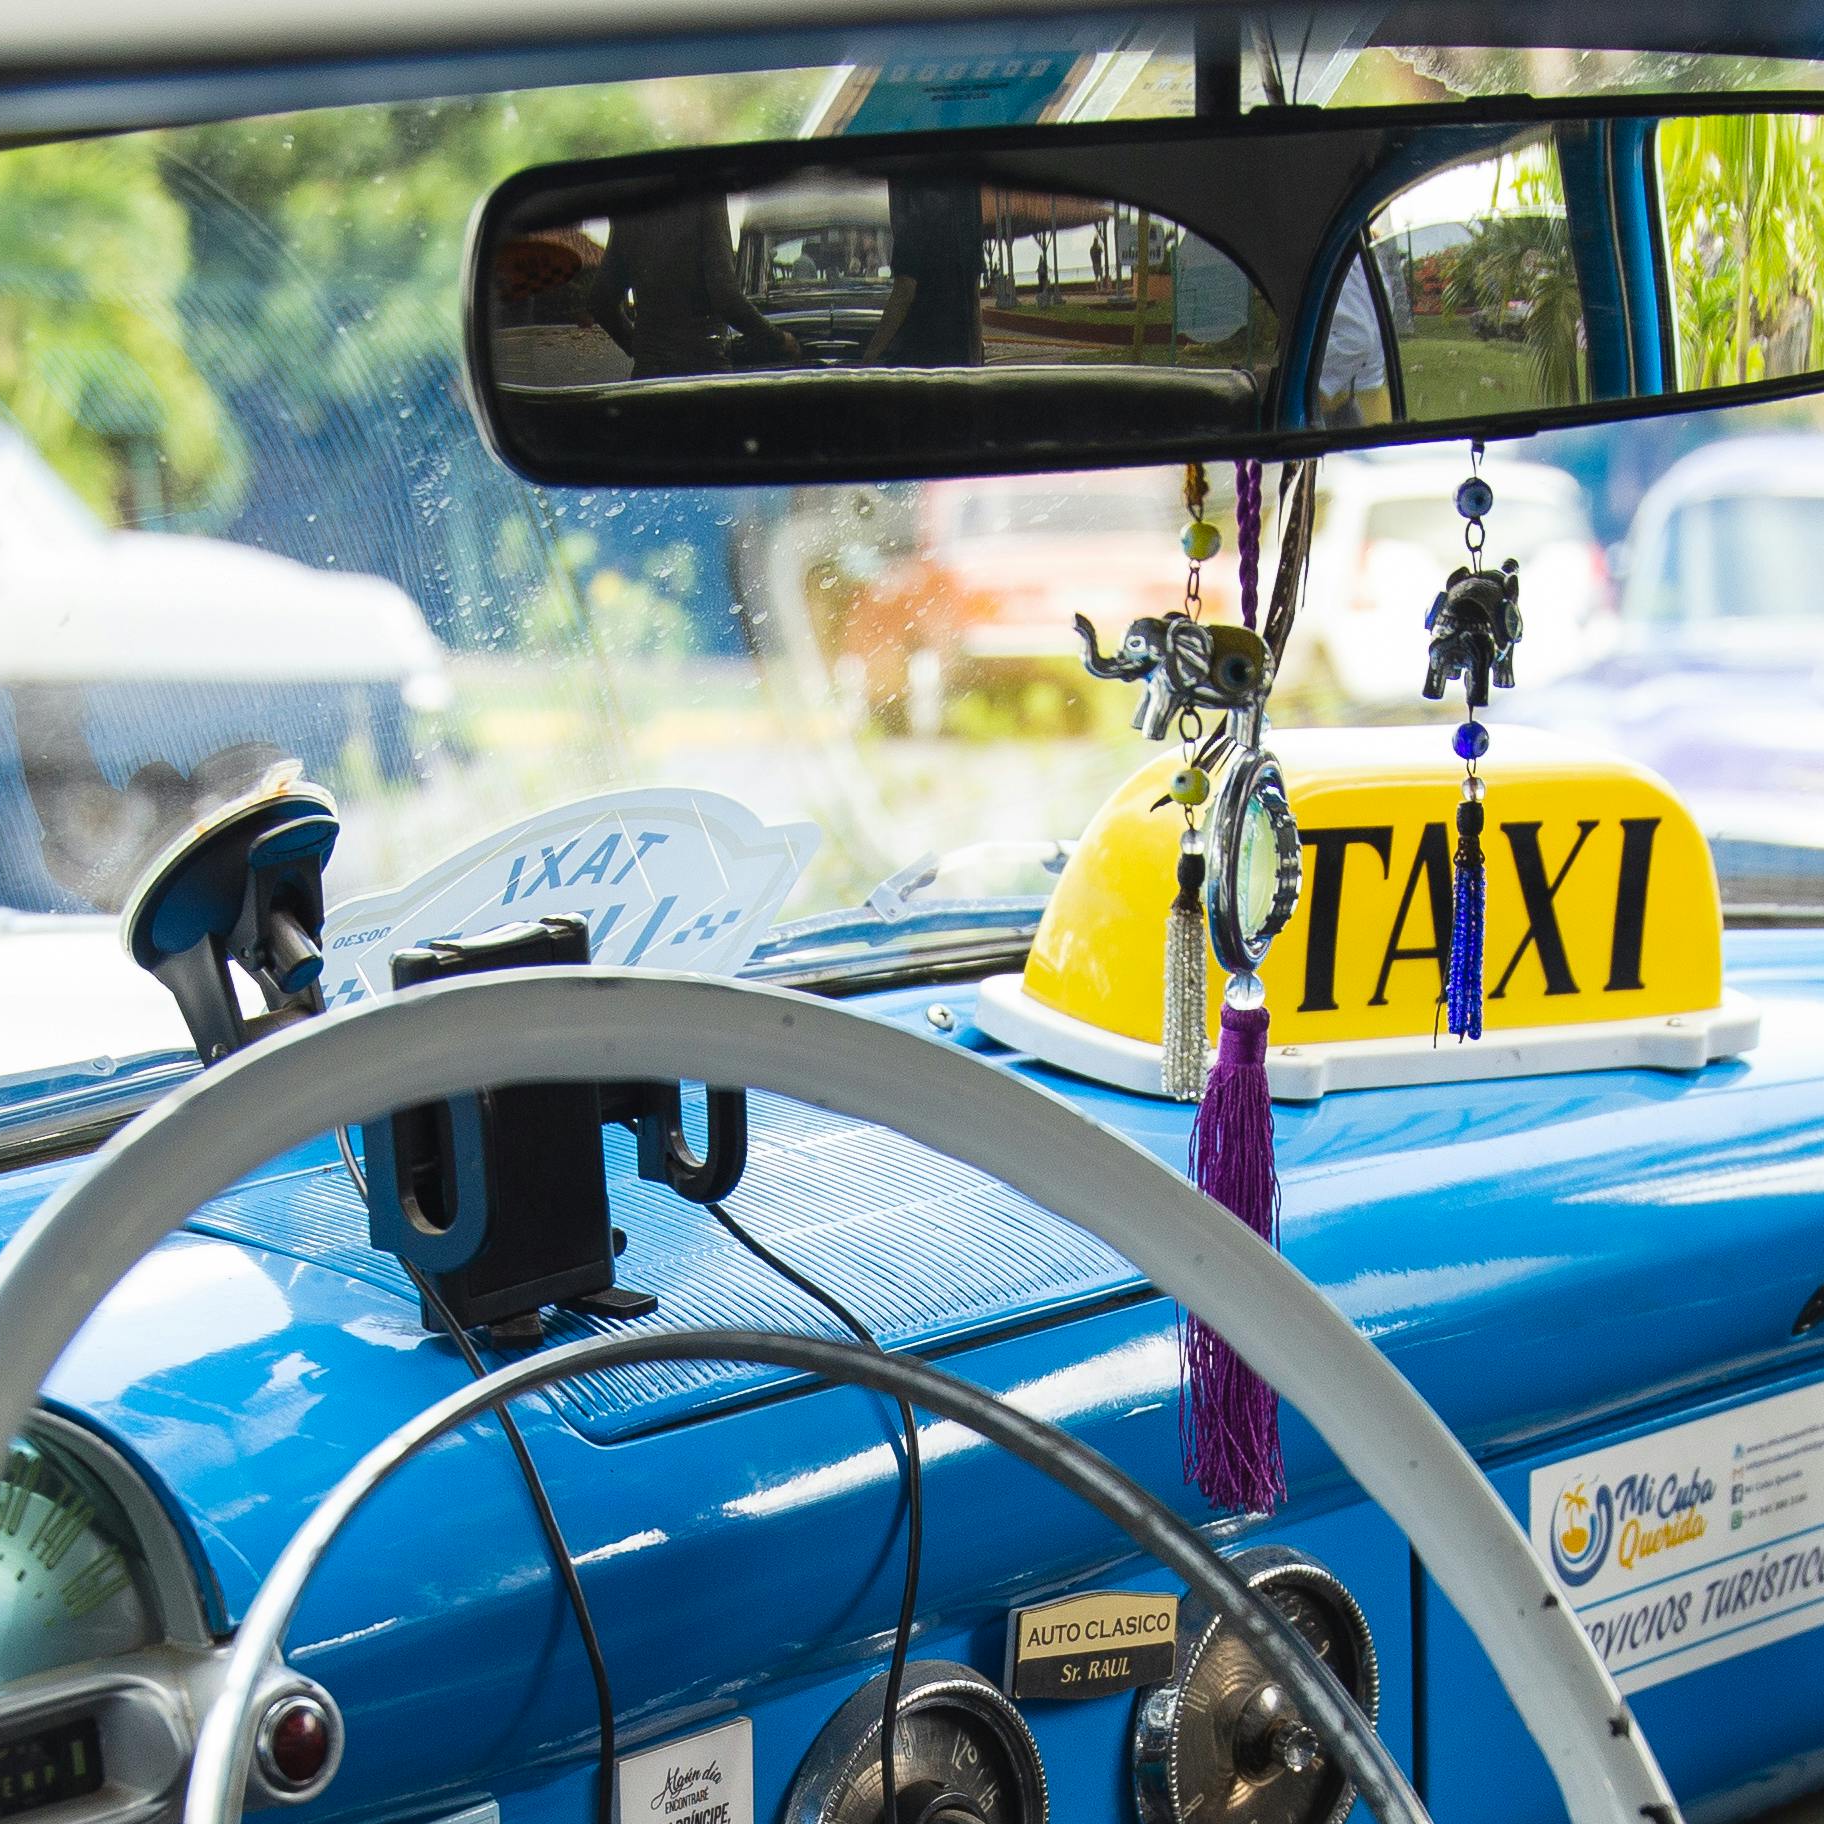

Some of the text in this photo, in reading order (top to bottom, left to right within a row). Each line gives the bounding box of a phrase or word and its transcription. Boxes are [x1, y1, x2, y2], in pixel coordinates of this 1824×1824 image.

[1297, 817, 1662, 1012] TAXI
[1615, 1472, 1656, 1521] Mi
[1657, 1467, 1716, 1519] Cuba
[1618, 1505, 1708, 1569] Querida
[1027, 1612, 1171, 1647] AUTO CLASICO
[1583, 1591, 1692, 1662] RVICIOS
[1060, 1657, 1130, 1683] Sr. RAUL
[651, 1760, 723, 1810] Algún día
[665, 1785, 709, 1814] ENCONTRARÉ
